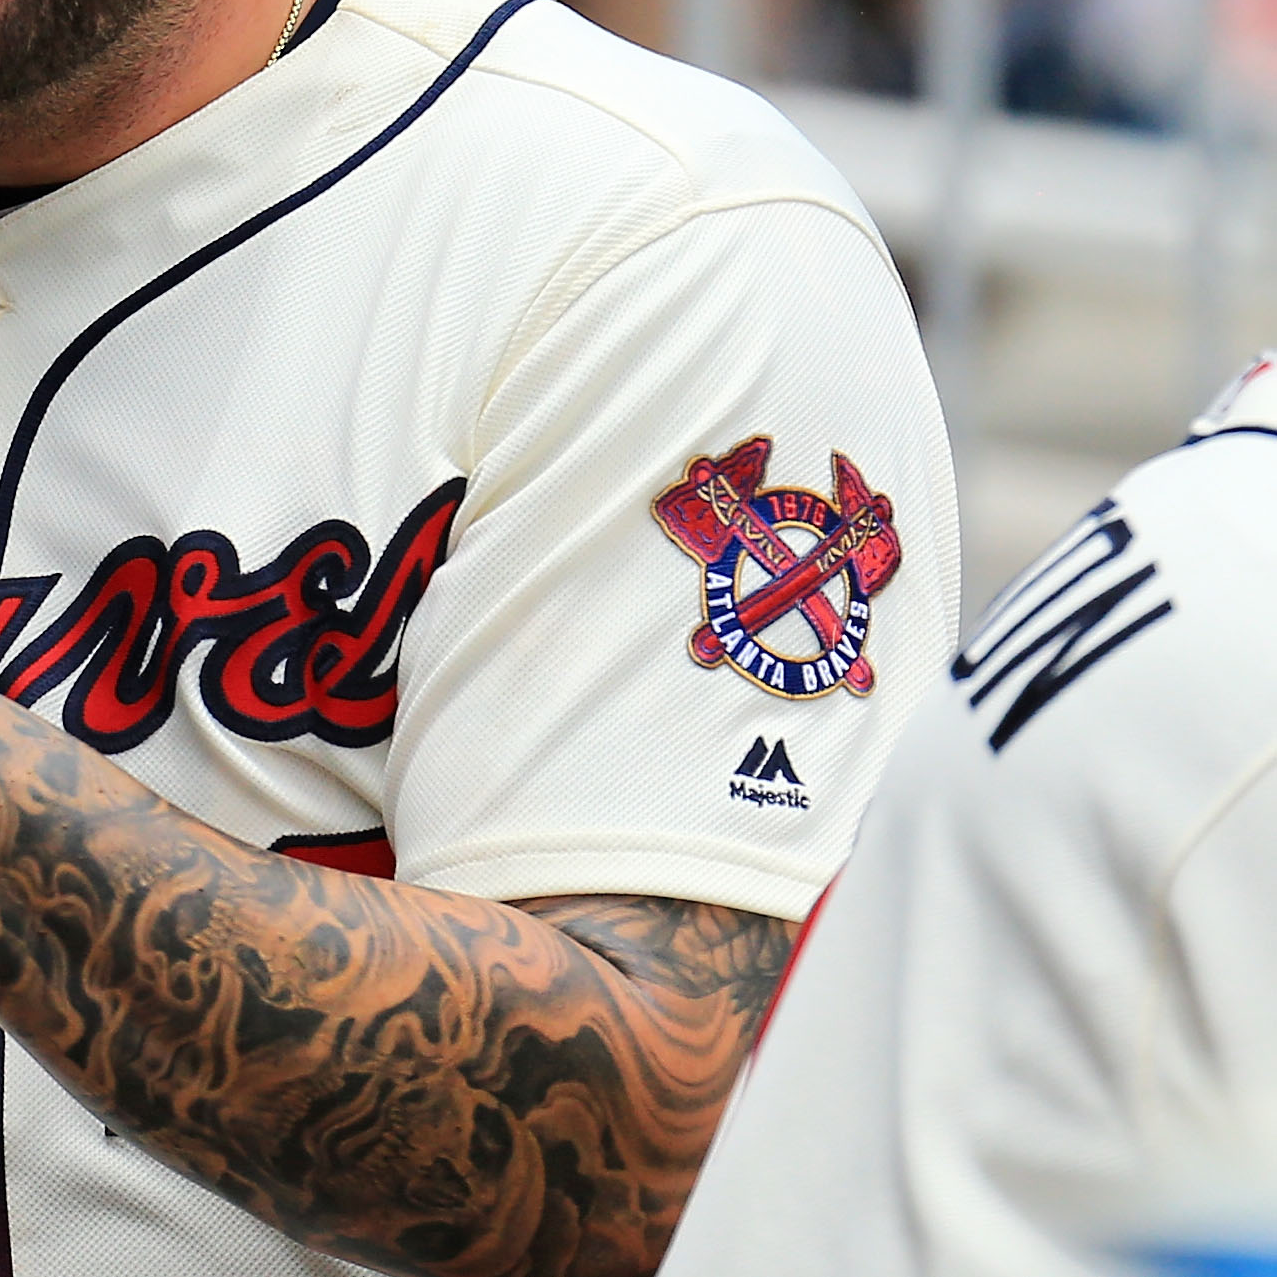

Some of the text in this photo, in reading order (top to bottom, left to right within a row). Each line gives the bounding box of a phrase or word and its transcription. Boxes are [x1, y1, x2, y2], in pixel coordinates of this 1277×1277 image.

[767, 494, 828, 527] 1876
[705, 570, 870, 693] ATLANTA BRAVES
[729, 780, 811, 811] Majestic
